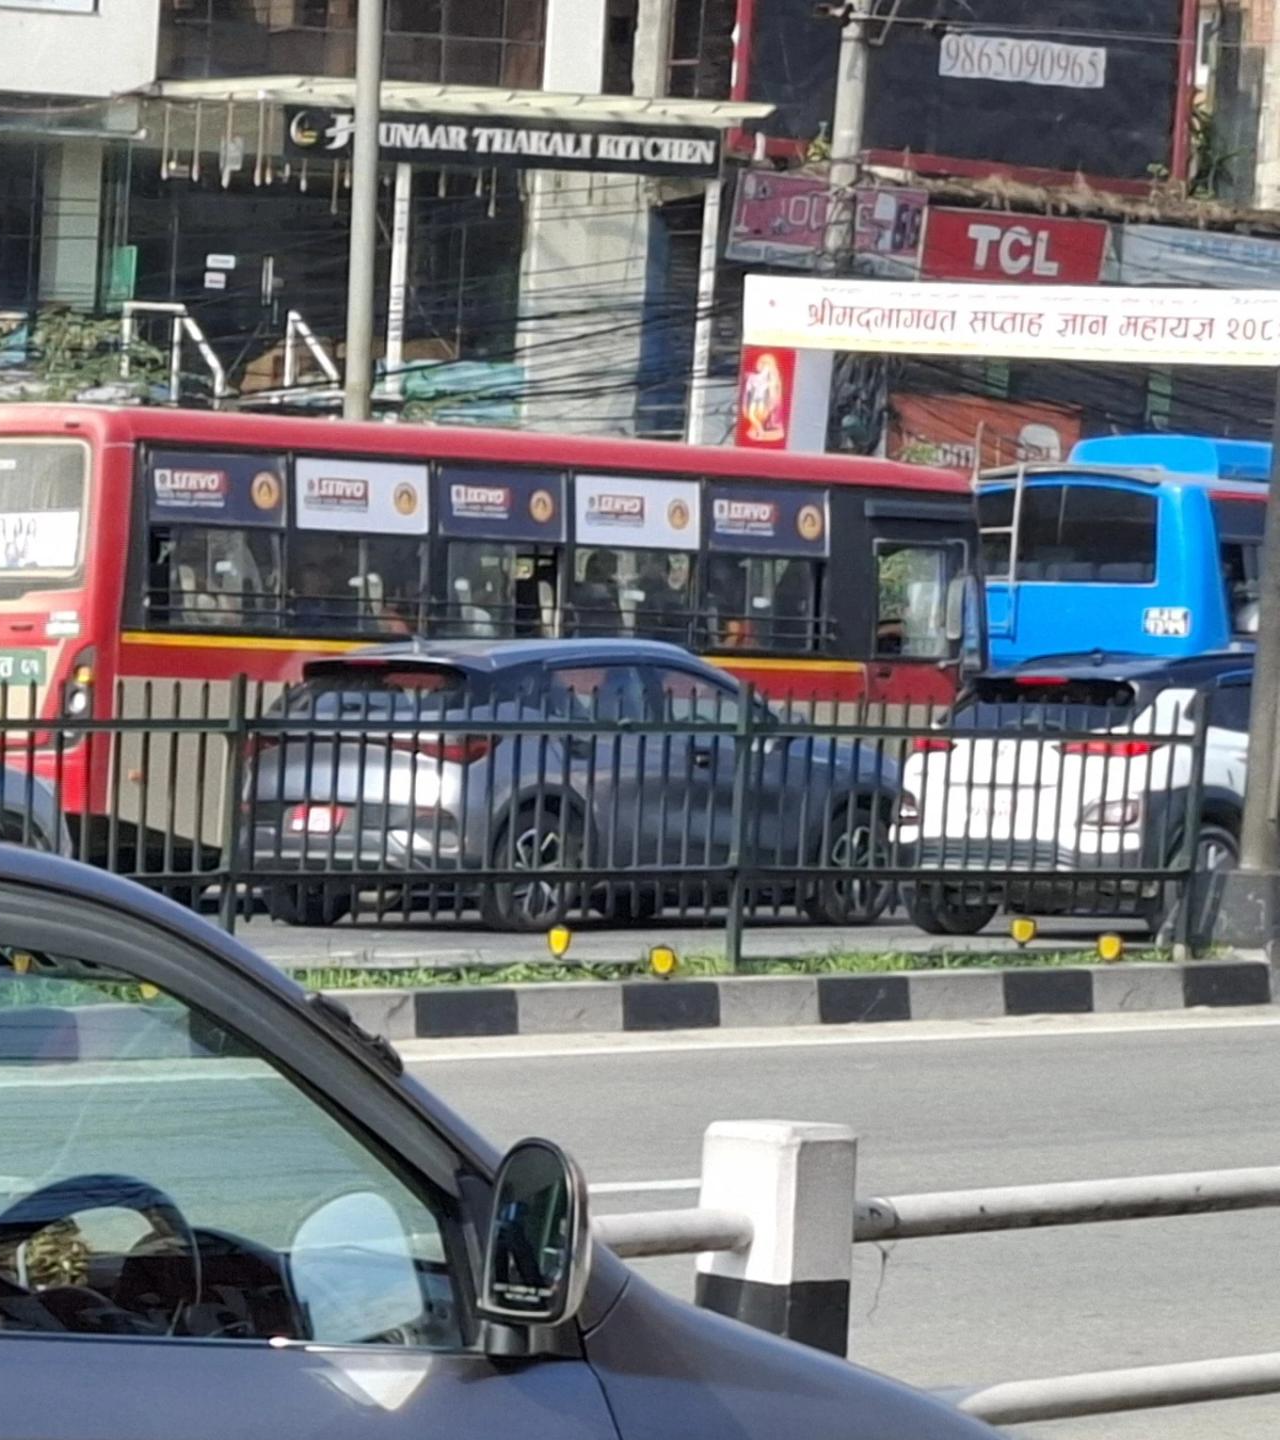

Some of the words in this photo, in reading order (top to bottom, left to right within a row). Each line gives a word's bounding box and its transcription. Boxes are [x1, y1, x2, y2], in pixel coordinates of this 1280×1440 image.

[945, 35, 1100, 86] 9865090965
[471, 127, 592, 159] THAKALI
[596, 133, 717, 165] KITCHEN
[968, 224, 1060, 276] TCL
[969, 309, 1045, 338] सप्ताह
[1226, 317, 1280, 342] २०८
